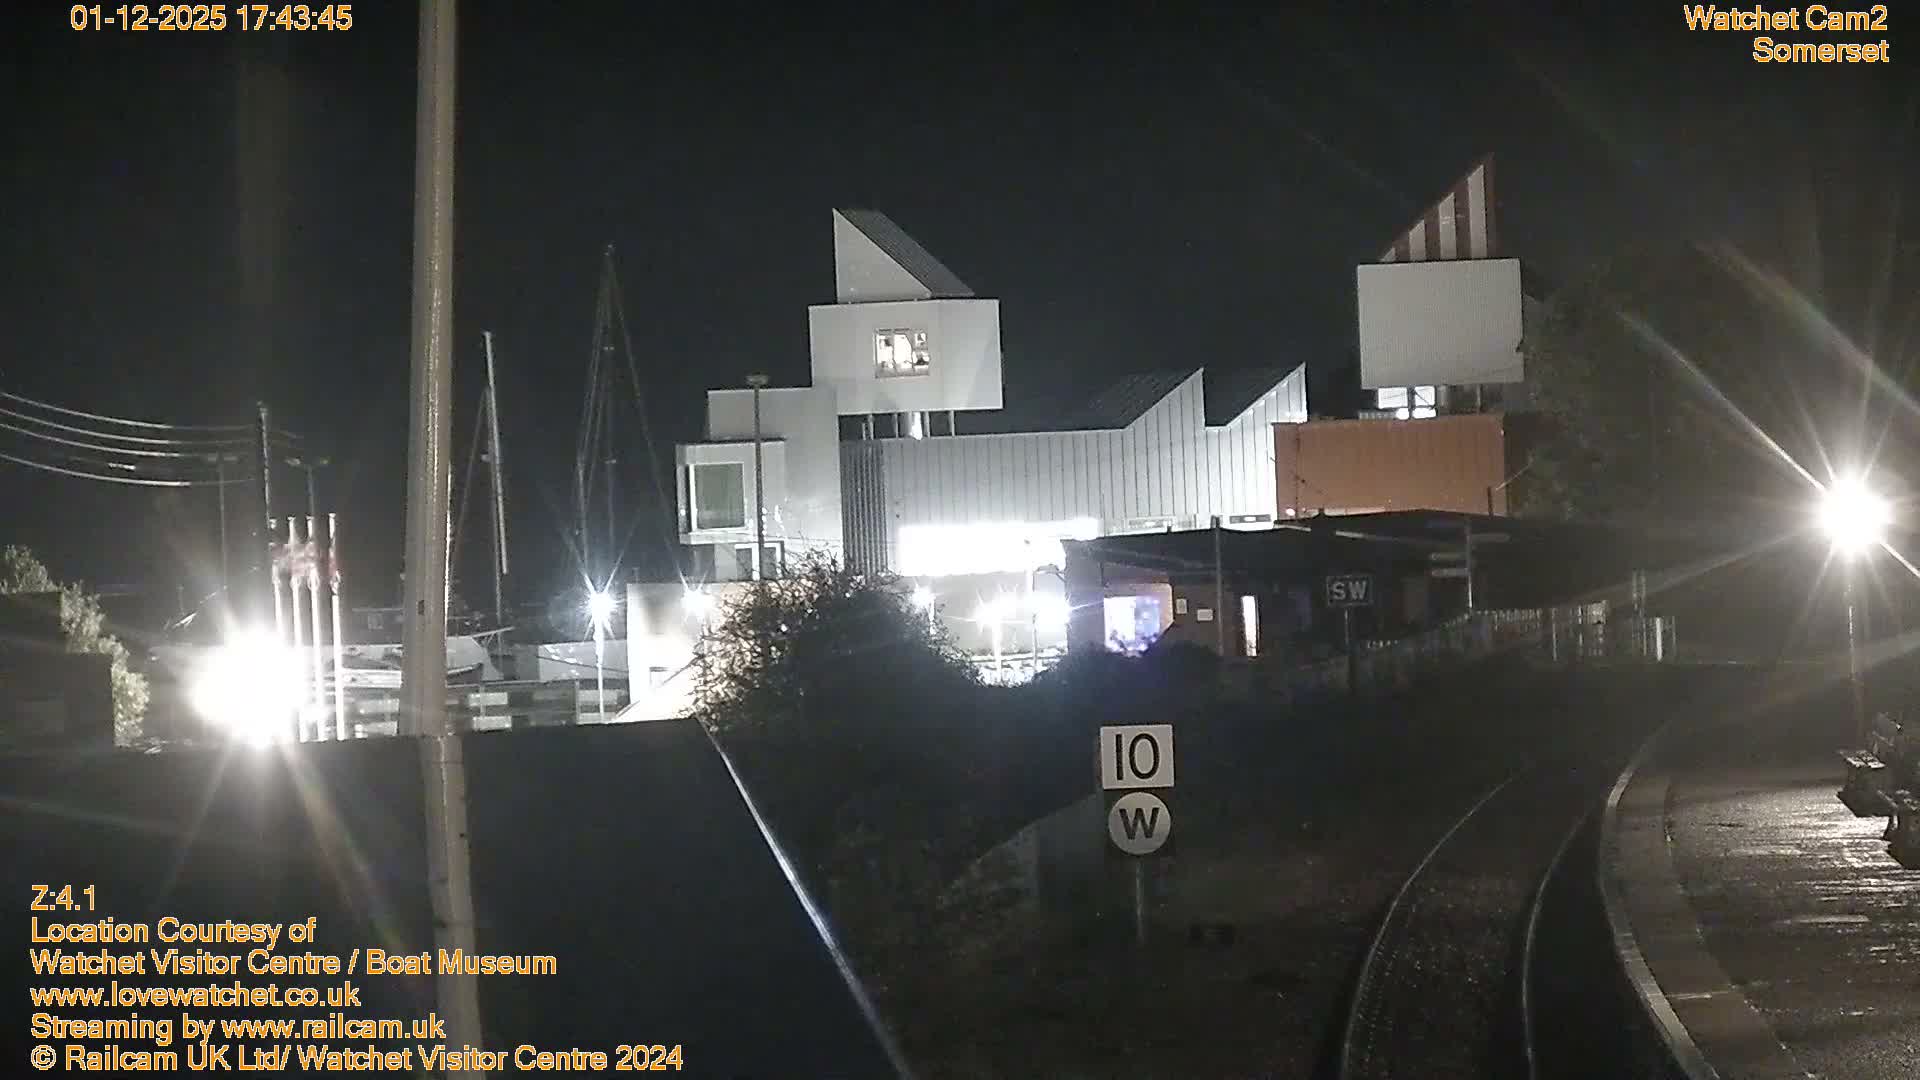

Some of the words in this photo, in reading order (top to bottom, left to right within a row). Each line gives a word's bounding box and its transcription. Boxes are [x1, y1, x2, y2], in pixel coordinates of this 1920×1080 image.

[1333, 580, 1367, 600] SW
[1115, 732, 1160, 781] 10
[1118, 806, 1160, 840] W
